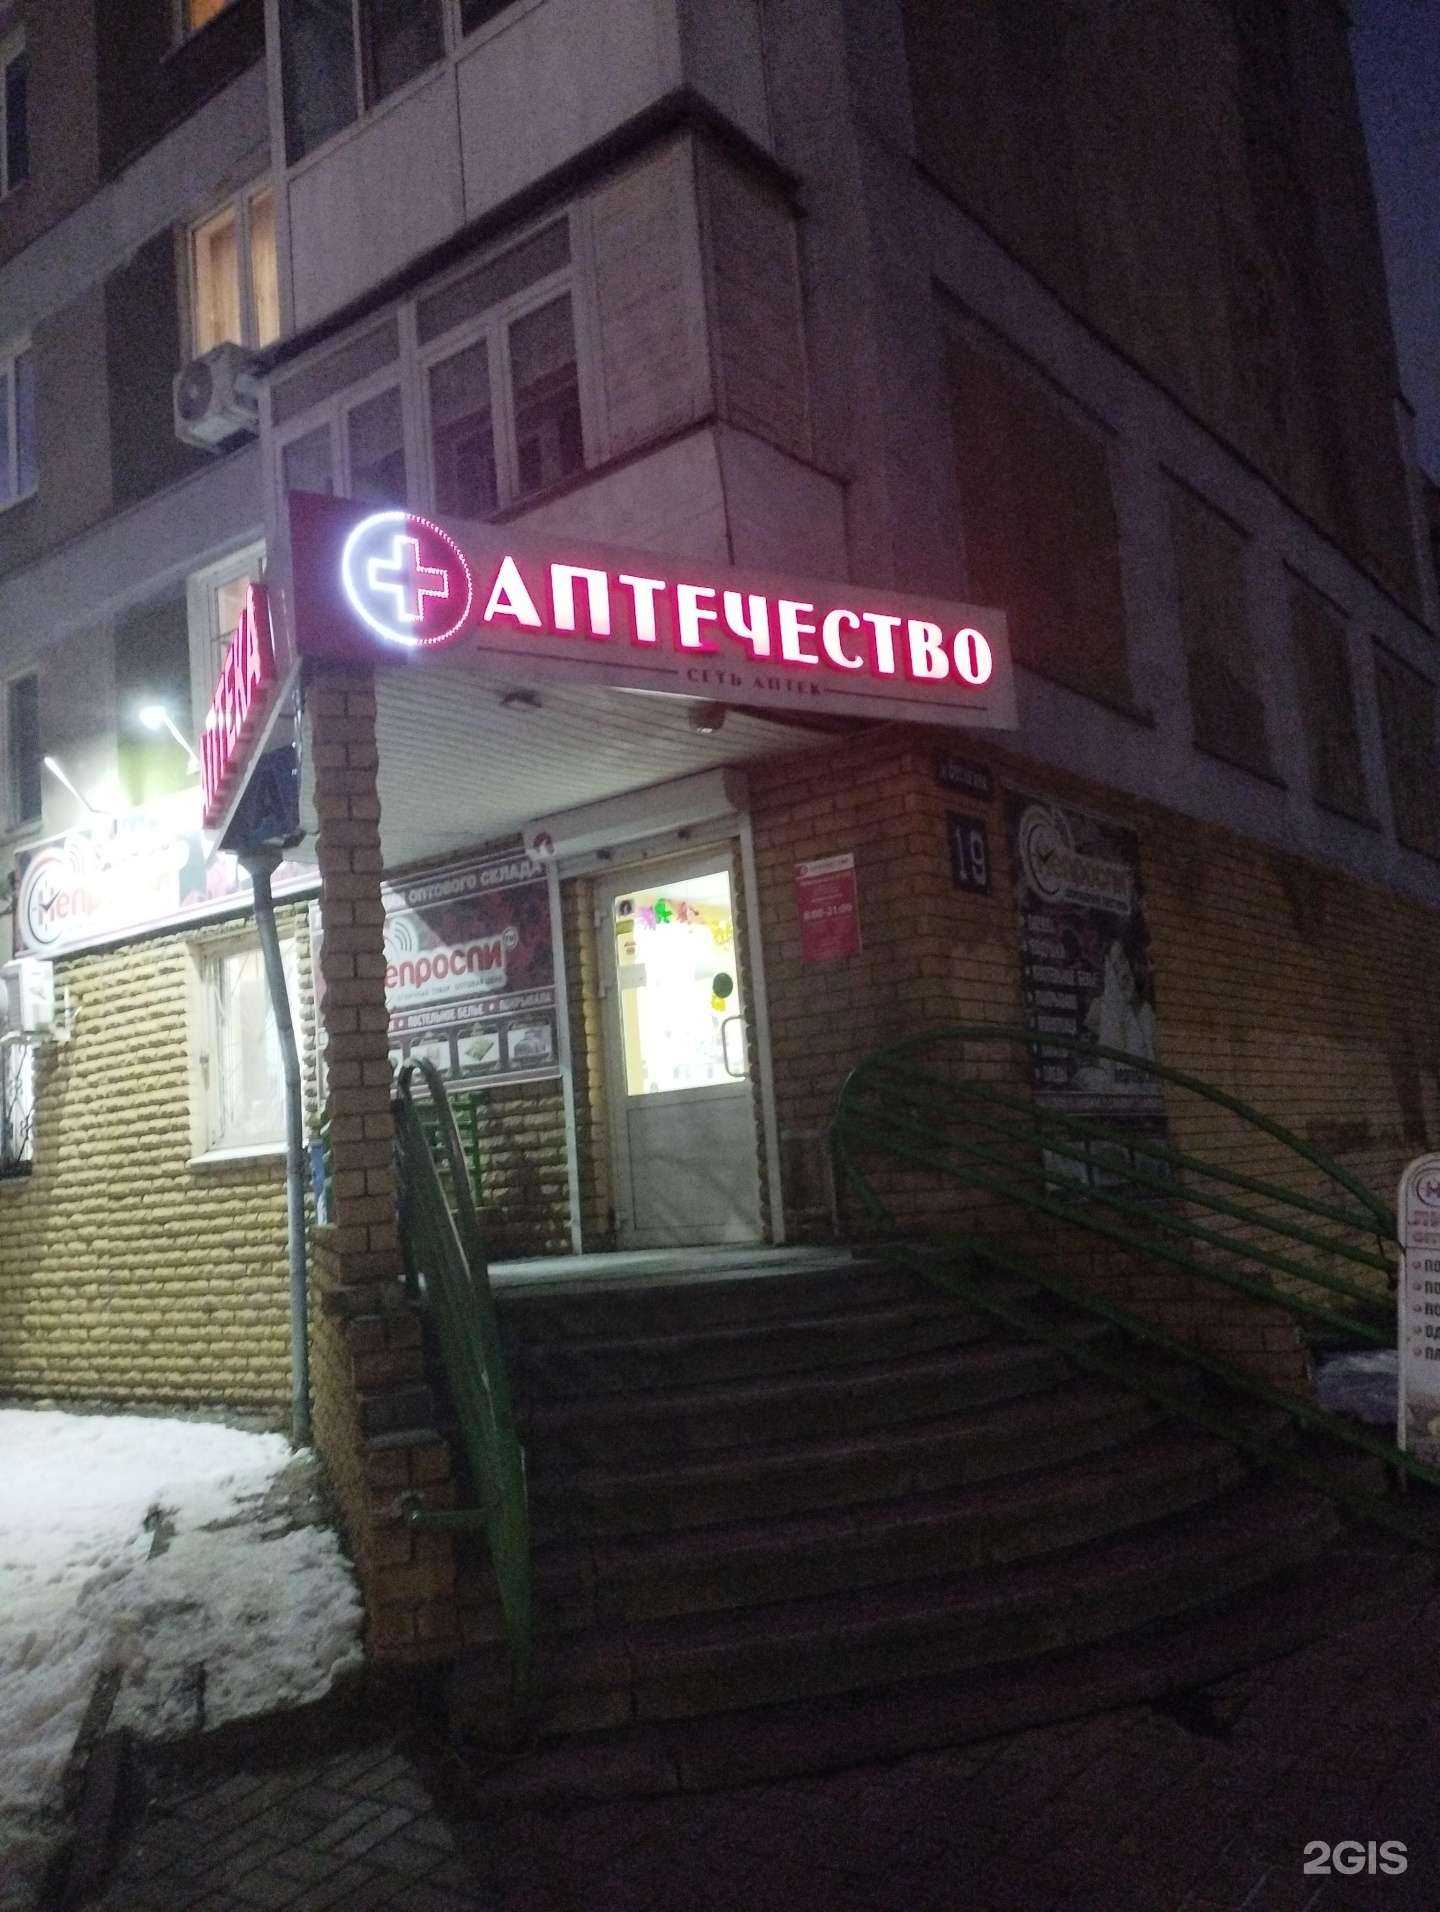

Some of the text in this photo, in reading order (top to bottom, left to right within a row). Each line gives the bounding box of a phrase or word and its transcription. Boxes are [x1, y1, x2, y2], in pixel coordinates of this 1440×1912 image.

[483, 555, 993, 685] АПТЕЧЕСТВО
[686, 667, 822, 695] СЕТЬ АПТЕК
[955, 823, 987, 886] 19
[385, 941, 502, 989] епроспи
